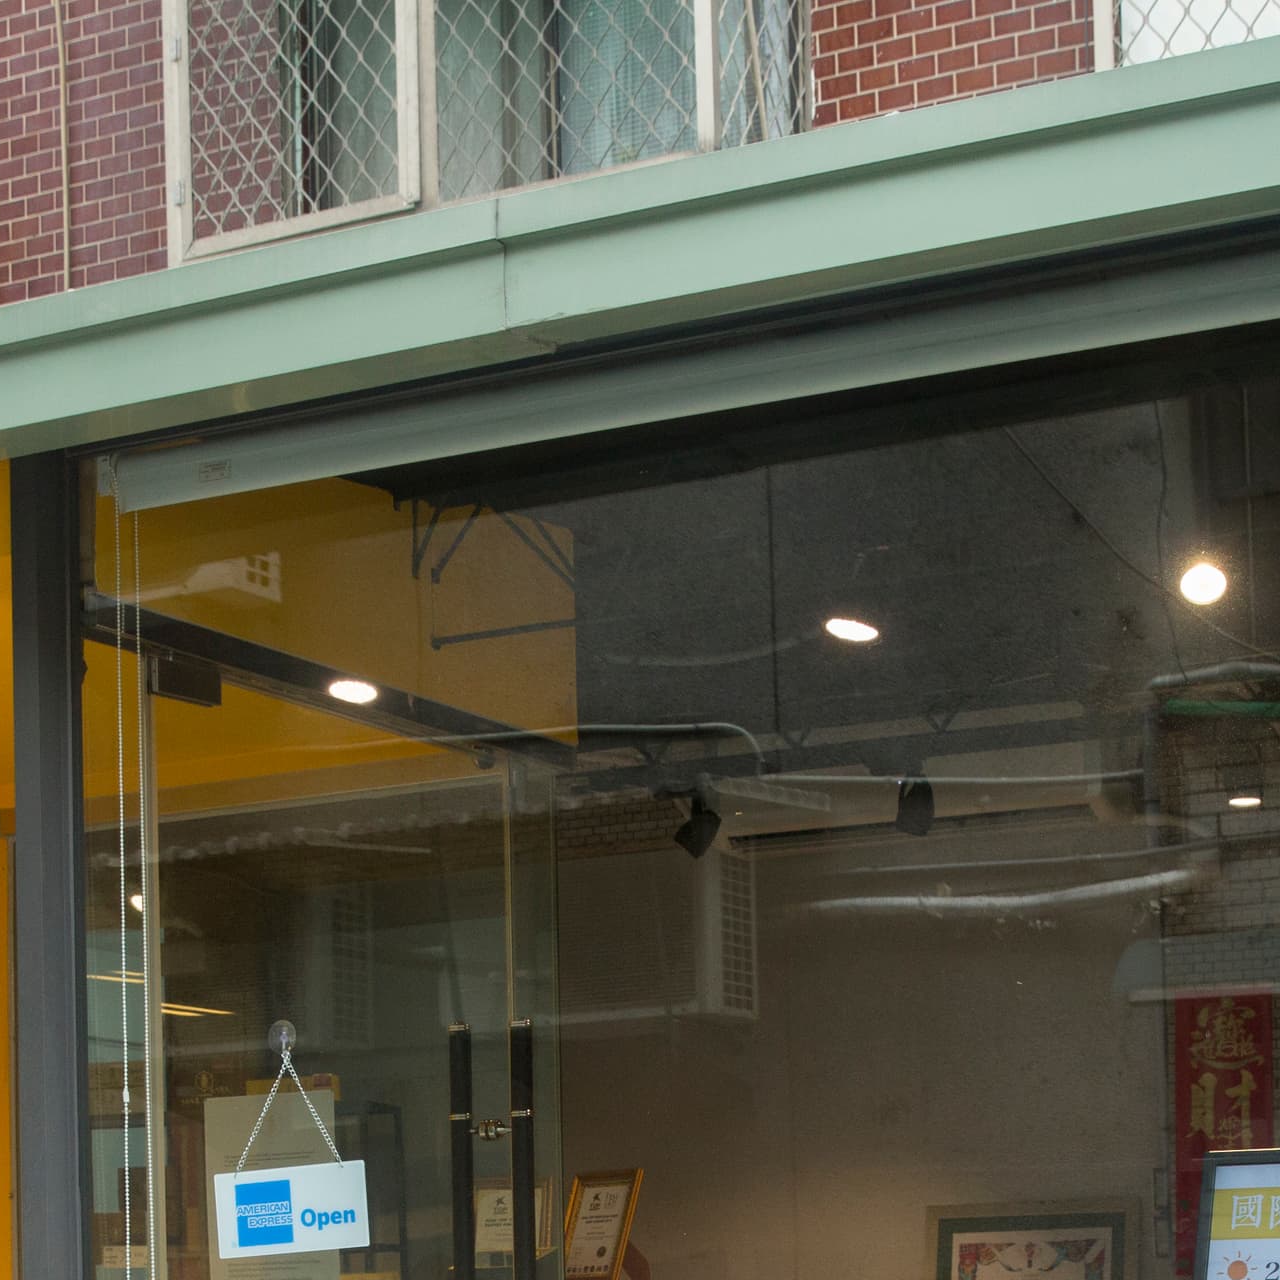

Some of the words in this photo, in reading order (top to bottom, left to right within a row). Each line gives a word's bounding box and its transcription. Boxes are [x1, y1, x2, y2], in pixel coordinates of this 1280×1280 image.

[237, 1202, 289, 1216] AMERICAN
[248, 1216, 293, 1228] EXPRESS
[300, 1208, 356, 1231] Open
